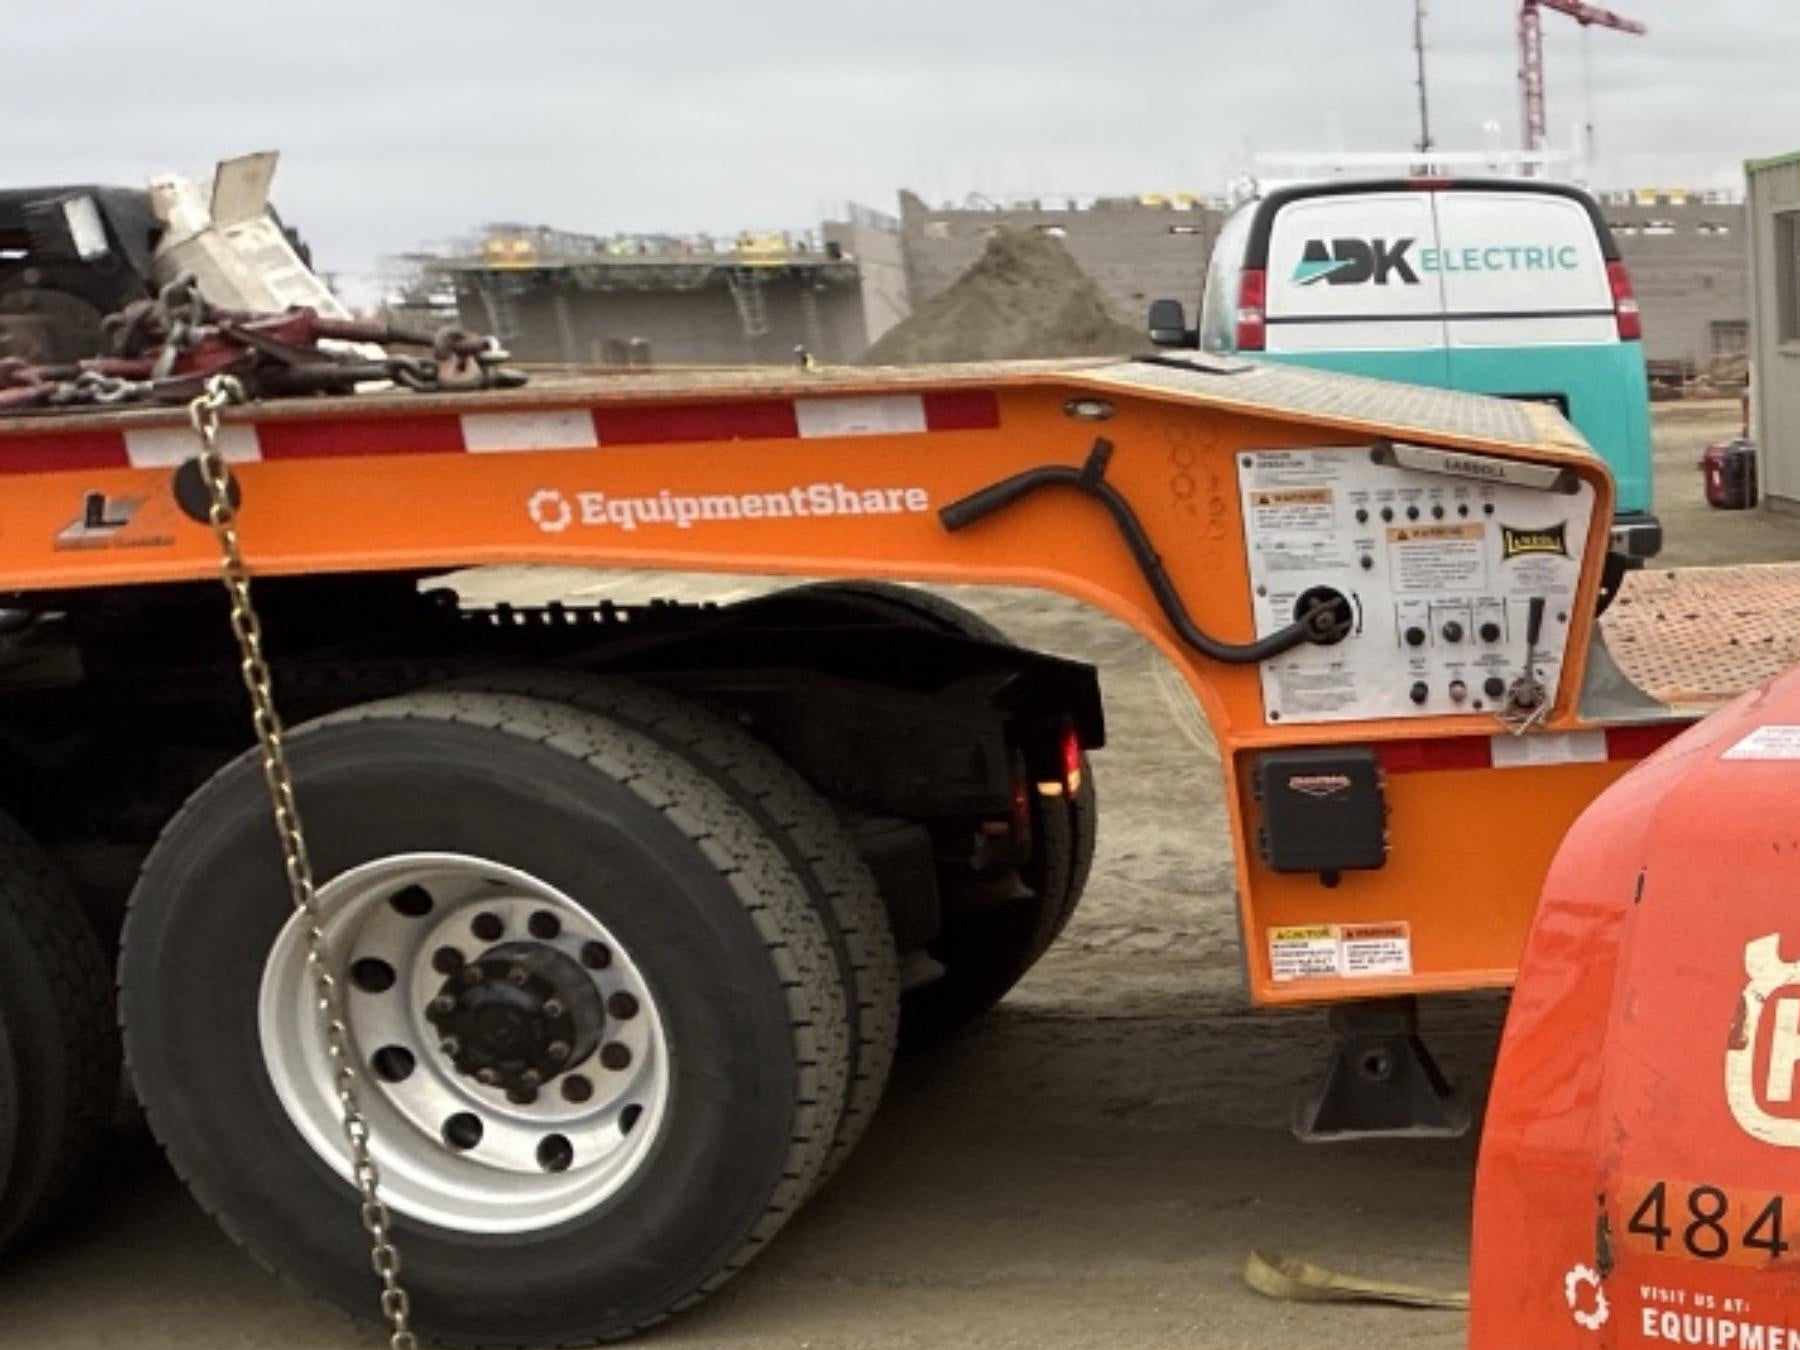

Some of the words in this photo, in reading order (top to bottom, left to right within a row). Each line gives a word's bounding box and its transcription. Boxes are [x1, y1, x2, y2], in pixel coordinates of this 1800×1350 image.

[1289, 238, 1420, 286] ADK
[1420, 246, 1578, 271] ELECTRIC
[577, 483, 928, 529] EquipmentShare
[1640, 1285, 1685, 1306] VISIT
[1694, 1294, 1715, 1309] US
